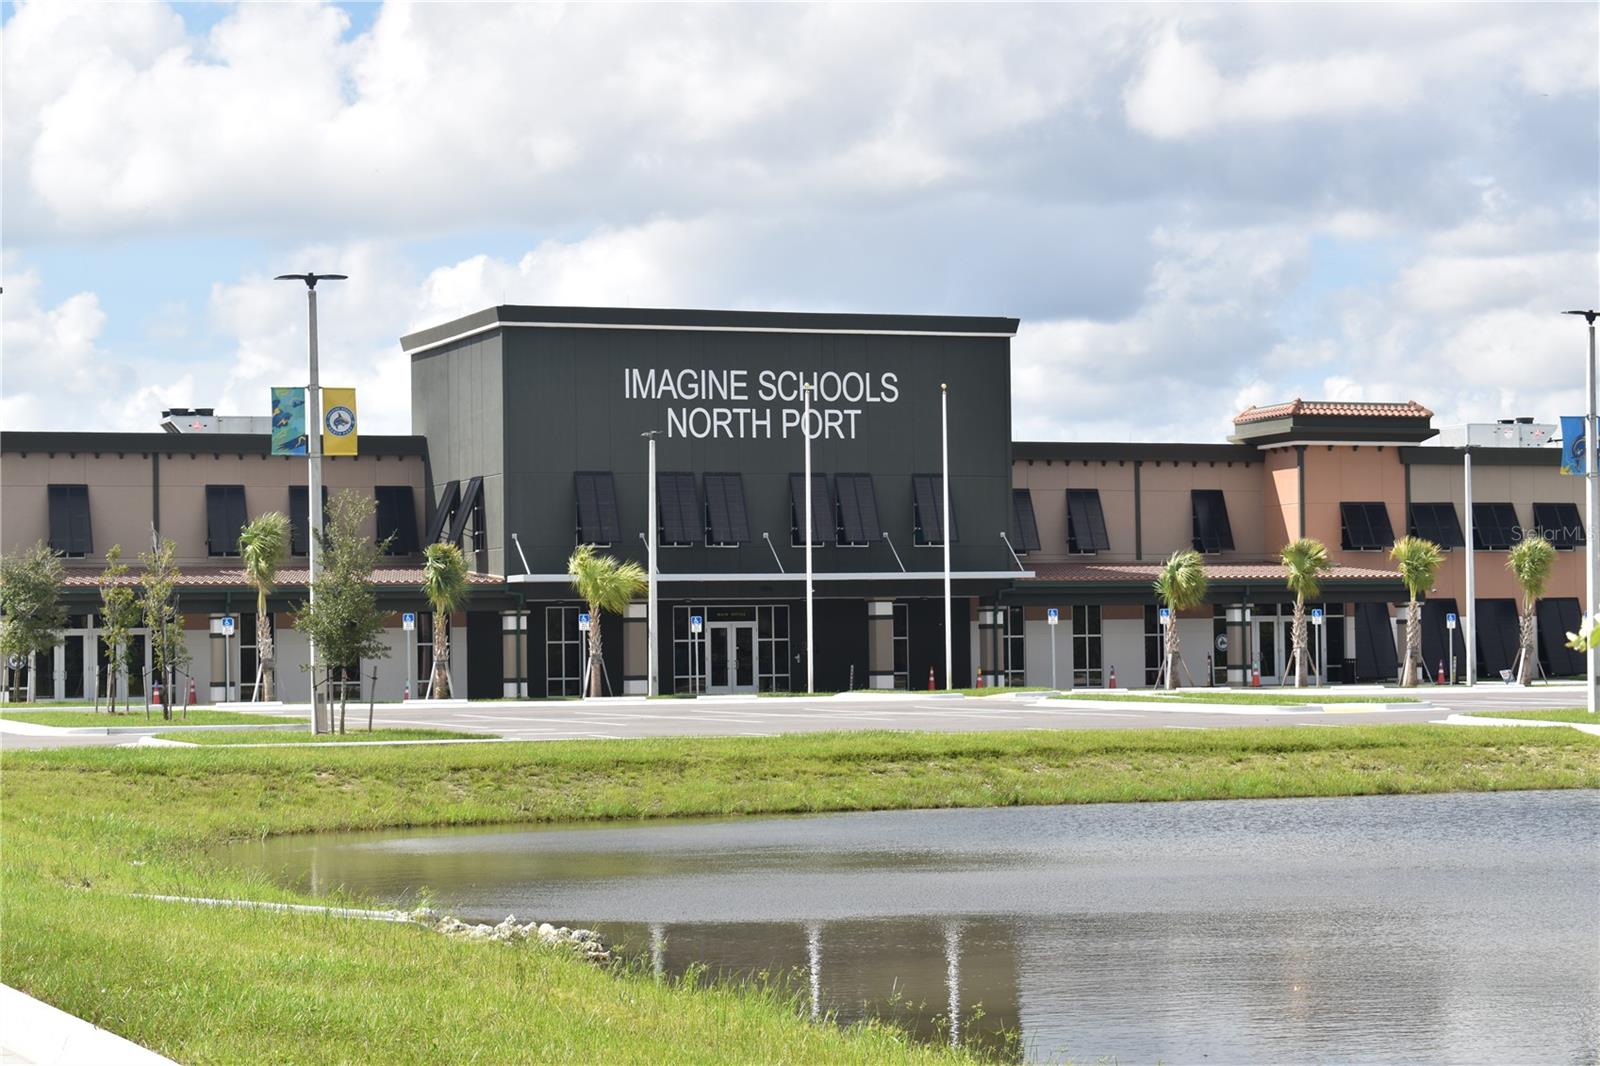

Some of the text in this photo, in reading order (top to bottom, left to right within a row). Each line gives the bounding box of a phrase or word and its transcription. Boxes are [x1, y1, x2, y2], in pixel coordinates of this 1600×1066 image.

[624, 368, 899, 403] IMAGINE SCHOOLS
[667, 407, 862, 440] NORTH PORT
